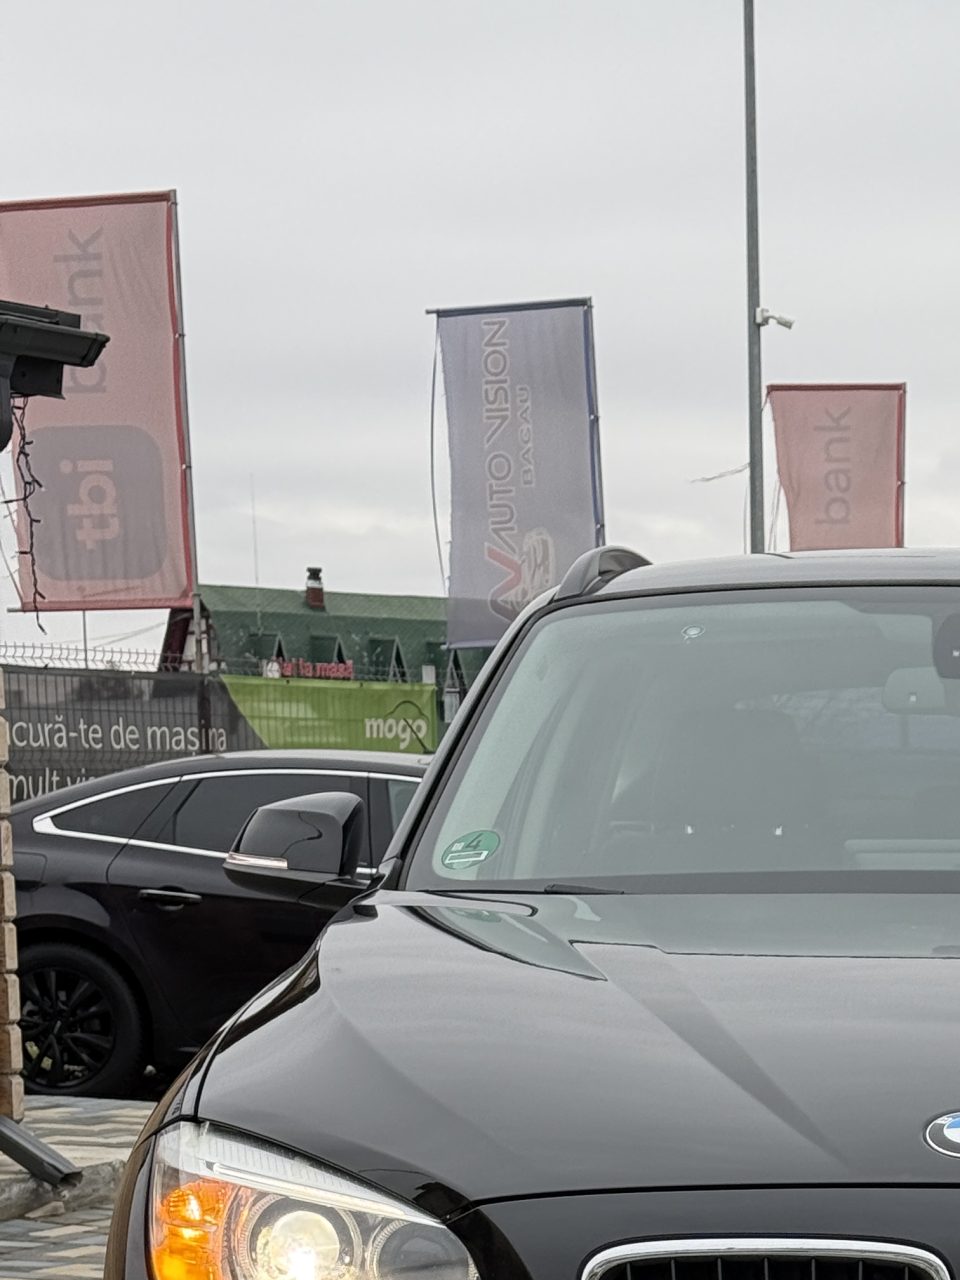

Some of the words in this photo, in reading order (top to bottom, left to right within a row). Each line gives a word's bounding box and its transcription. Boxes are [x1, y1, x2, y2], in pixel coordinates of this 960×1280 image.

[53, 228, 107, 394] bnk
[483, 318, 510, 448] VISION
[517, 386, 535, 487] BACAU
[814, 405, 853, 528] bank
[59, 459, 121, 552] tbi
[486, 452, 517, 555] AUTO
[7, 714, 103, 749] cură-te
[110, 716, 140, 750] de
[365, 717, 428, 749] mogo
[9, 767, 60, 799] mult
